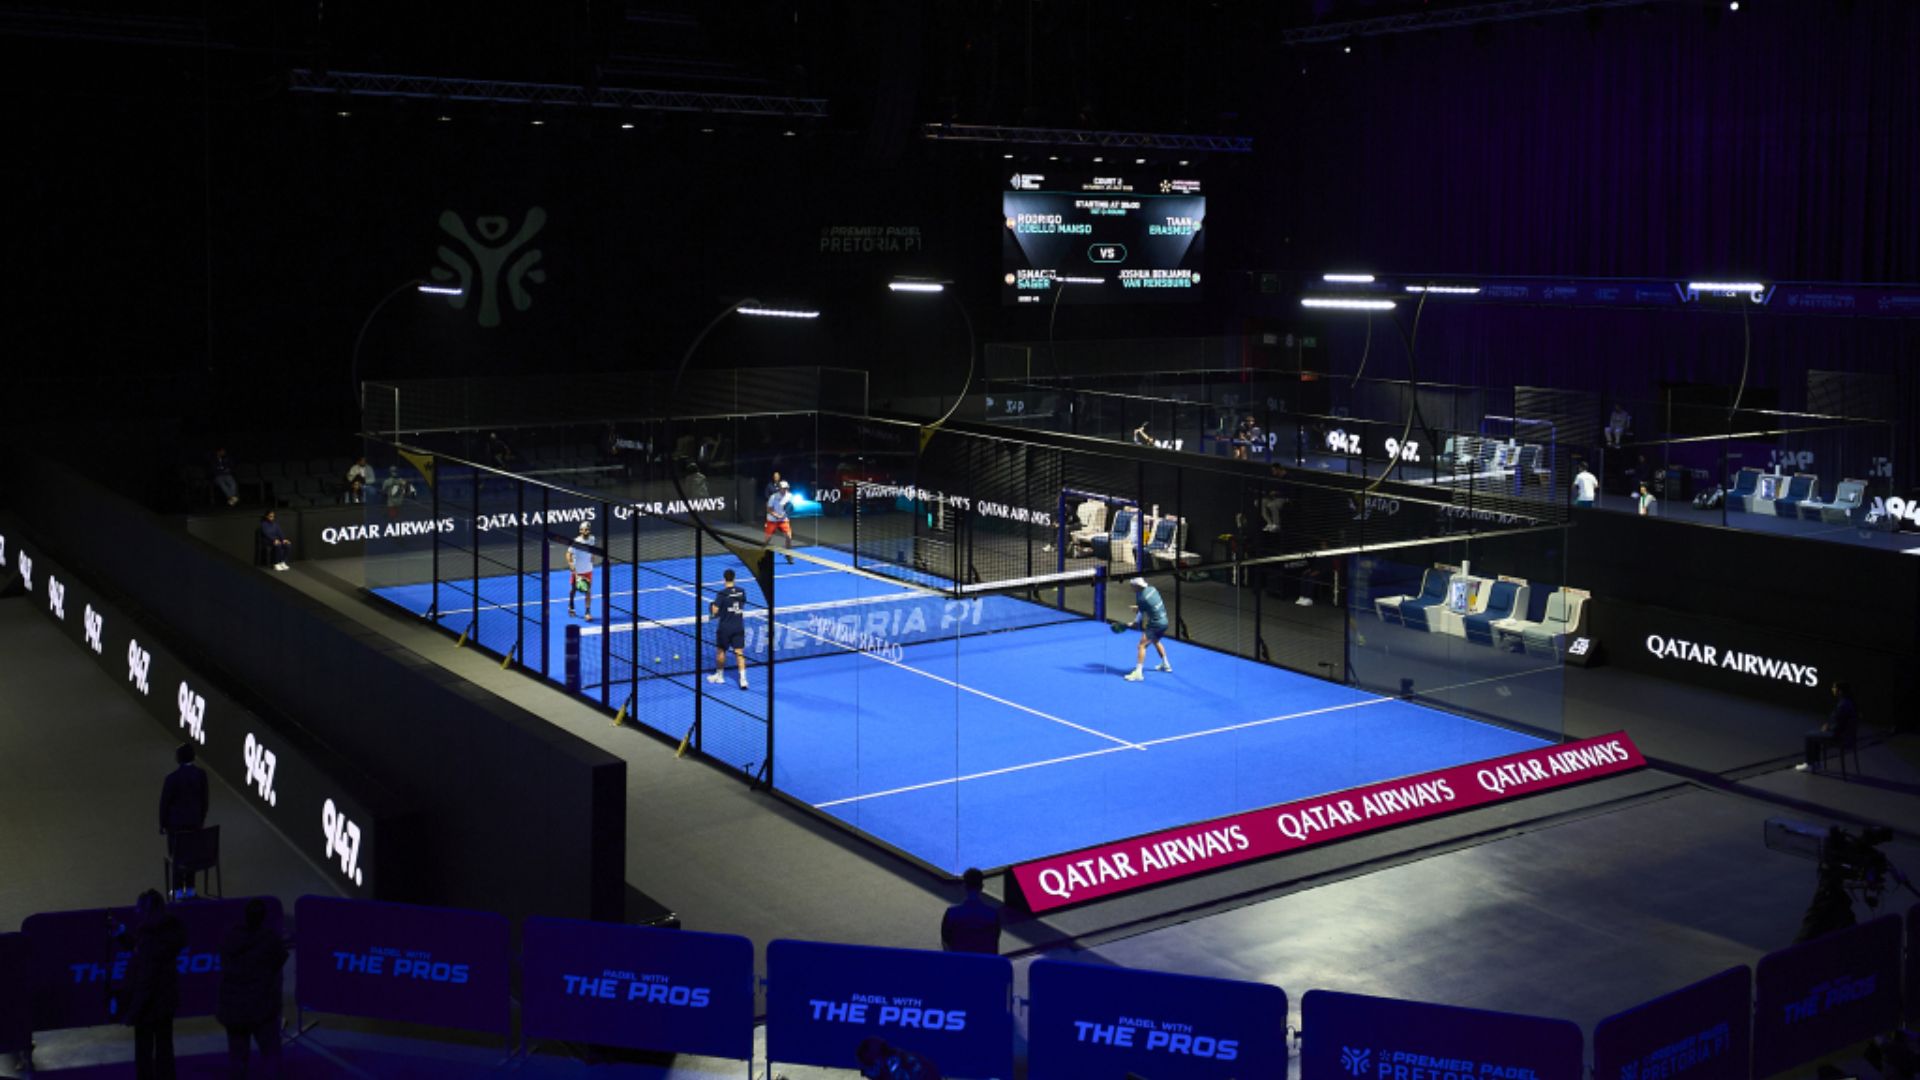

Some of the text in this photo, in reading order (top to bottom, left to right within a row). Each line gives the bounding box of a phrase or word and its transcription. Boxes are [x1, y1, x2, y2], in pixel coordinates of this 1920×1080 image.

[1017, 214, 1062, 223] RODRIGO
[1149, 225, 1192, 235] ERASMUS
[1100, 248, 1115, 258] VS
[322, 518, 455, 544] QATAR AIRWAYS
[532, 508, 595, 525] ARWAYS
[1646, 635, 1818, 687] QATAR AIRWAYS
[178, 681, 205, 744] 947.
[243, 732, 276, 807] 947.
[1476, 740, 1629, 793] QATAR AIRWAYS
[1277, 778, 1455, 840] QATAR AIRWAYS
[322, 798, 363, 886] 947.
[1038, 825, 1250, 898] QATAR AIRWAYS
[333, 951, 470, 984] THE PROS
[562, 974, 710, 1008] THE PROS
[852, 993, 924, 1008] PADEL WITH
[809, 999, 967, 1031] THE PROS
[1118, 1016, 1193, 1033] PADEL WITH
[1073, 1020, 1239, 1061] THE PROS
[1392, 1050, 1540, 1080] PREMIER PADEL
